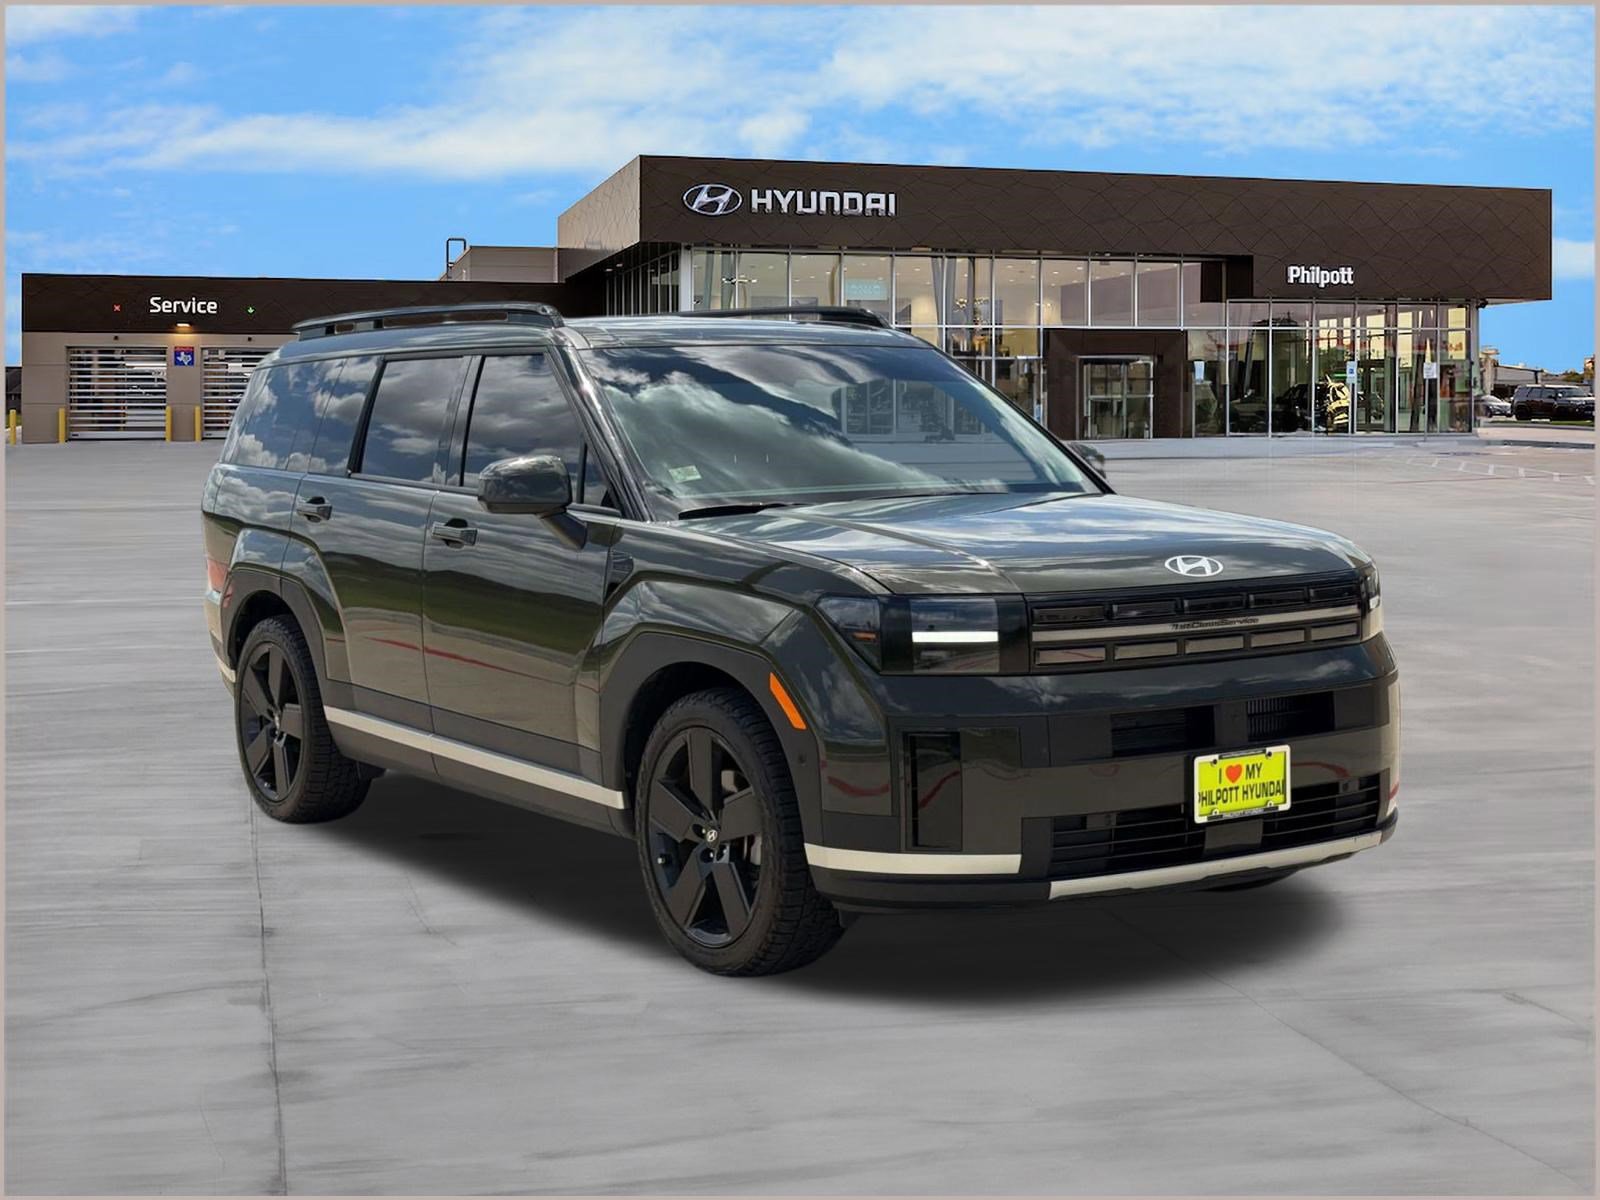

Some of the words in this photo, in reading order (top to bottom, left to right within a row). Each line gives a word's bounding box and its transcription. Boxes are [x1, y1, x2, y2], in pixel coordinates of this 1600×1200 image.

[751, 188, 896, 216] HYUNDAI
[1287, 265, 1354, 288] Philpott
[149, 296, 218, 314] Service
[1245, 762, 1263, 780] MY
[1242, 779, 1285, 801] HYUNDAI
